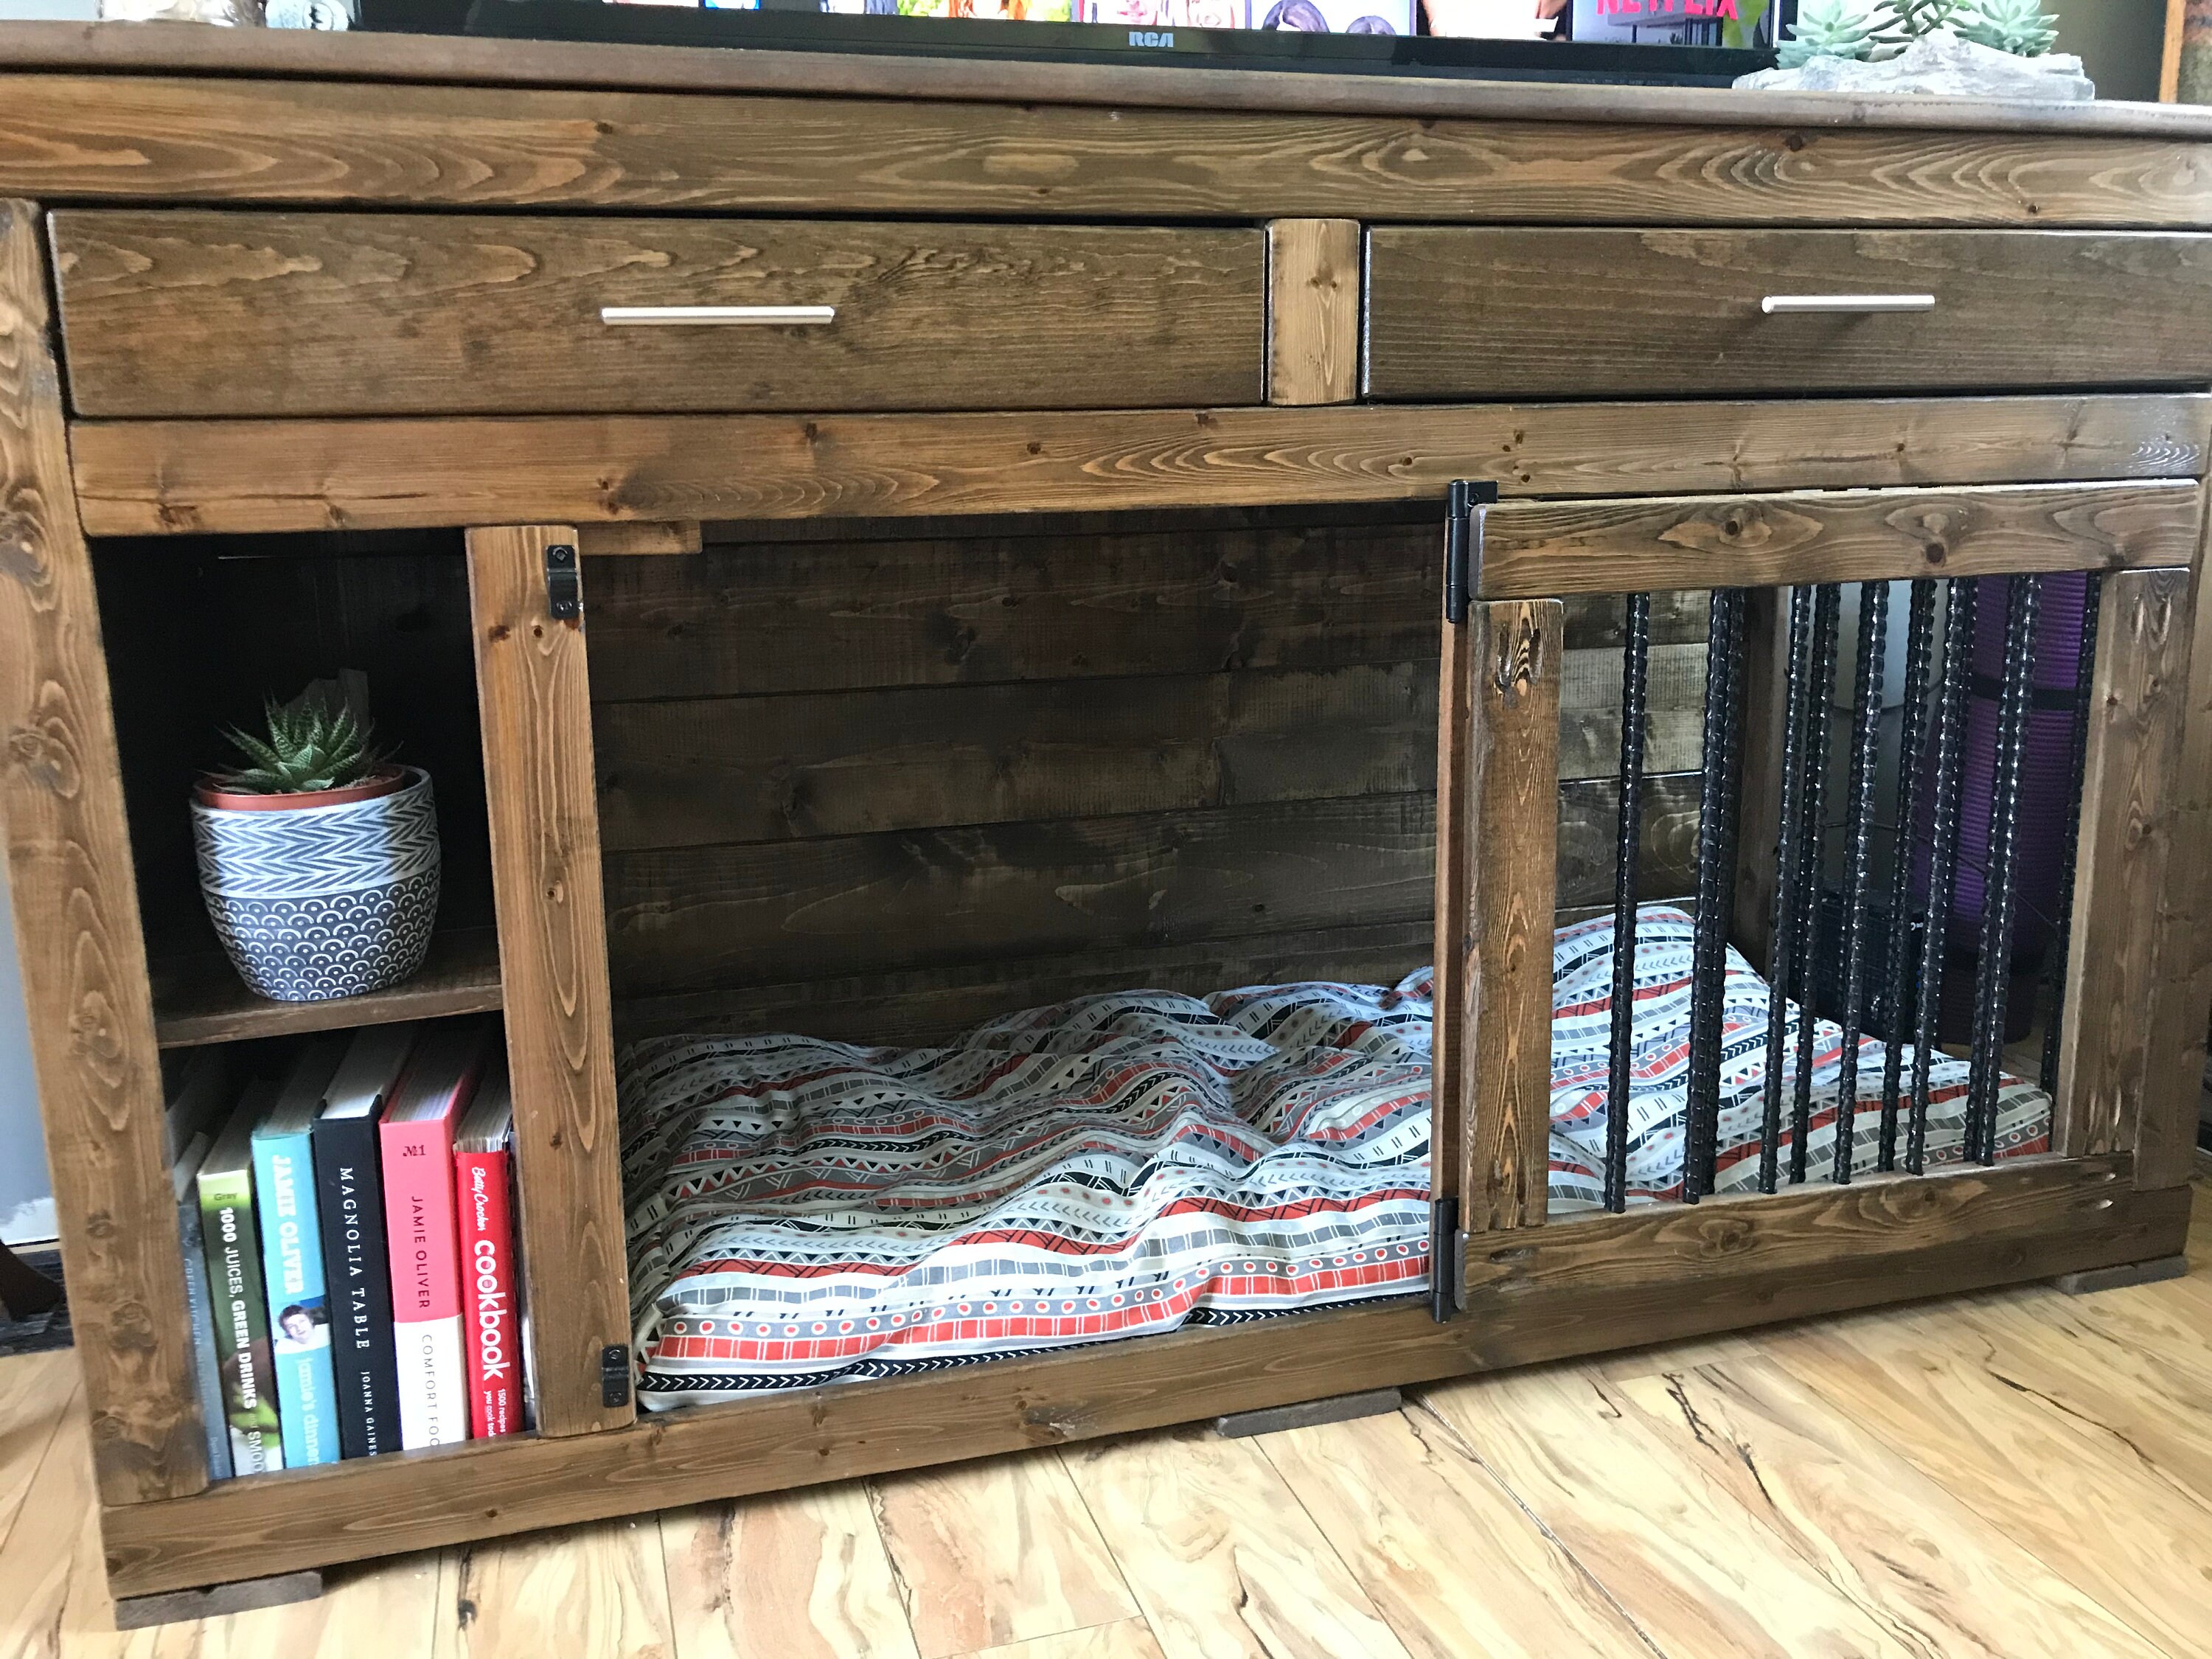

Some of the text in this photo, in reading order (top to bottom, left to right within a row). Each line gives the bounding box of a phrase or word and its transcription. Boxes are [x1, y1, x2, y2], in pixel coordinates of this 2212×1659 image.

[1129, 32, 1174, 47] RCA
[220, 1206, 237, 1242] 1000
[272, 1155, 304, 1295] JAMIE OLIVER
[471, 1166, 489, 1231] Betty Crocker
[224, 1247, 243, 1298] JUICES,
[340, 1167, 370, 1349] MAGNOLIA TABLE
[411, 1196, 430, 1308] JAMIE OLIVER
[232, 1300, 251, 1349] GREEN
[474, 1239, 510, 1381] cookbook
[238, 1352, 257, 1409] DRINKS
[422, 1335, 437, 1408] COMFORT
[484, 1391, 492, 1405] you
[361, 1371, 378, 1456] JOANNA GAINES
[486, 1405, 495, 1422] cook
[497, 1388, 507, 1433] 1500 recipes
